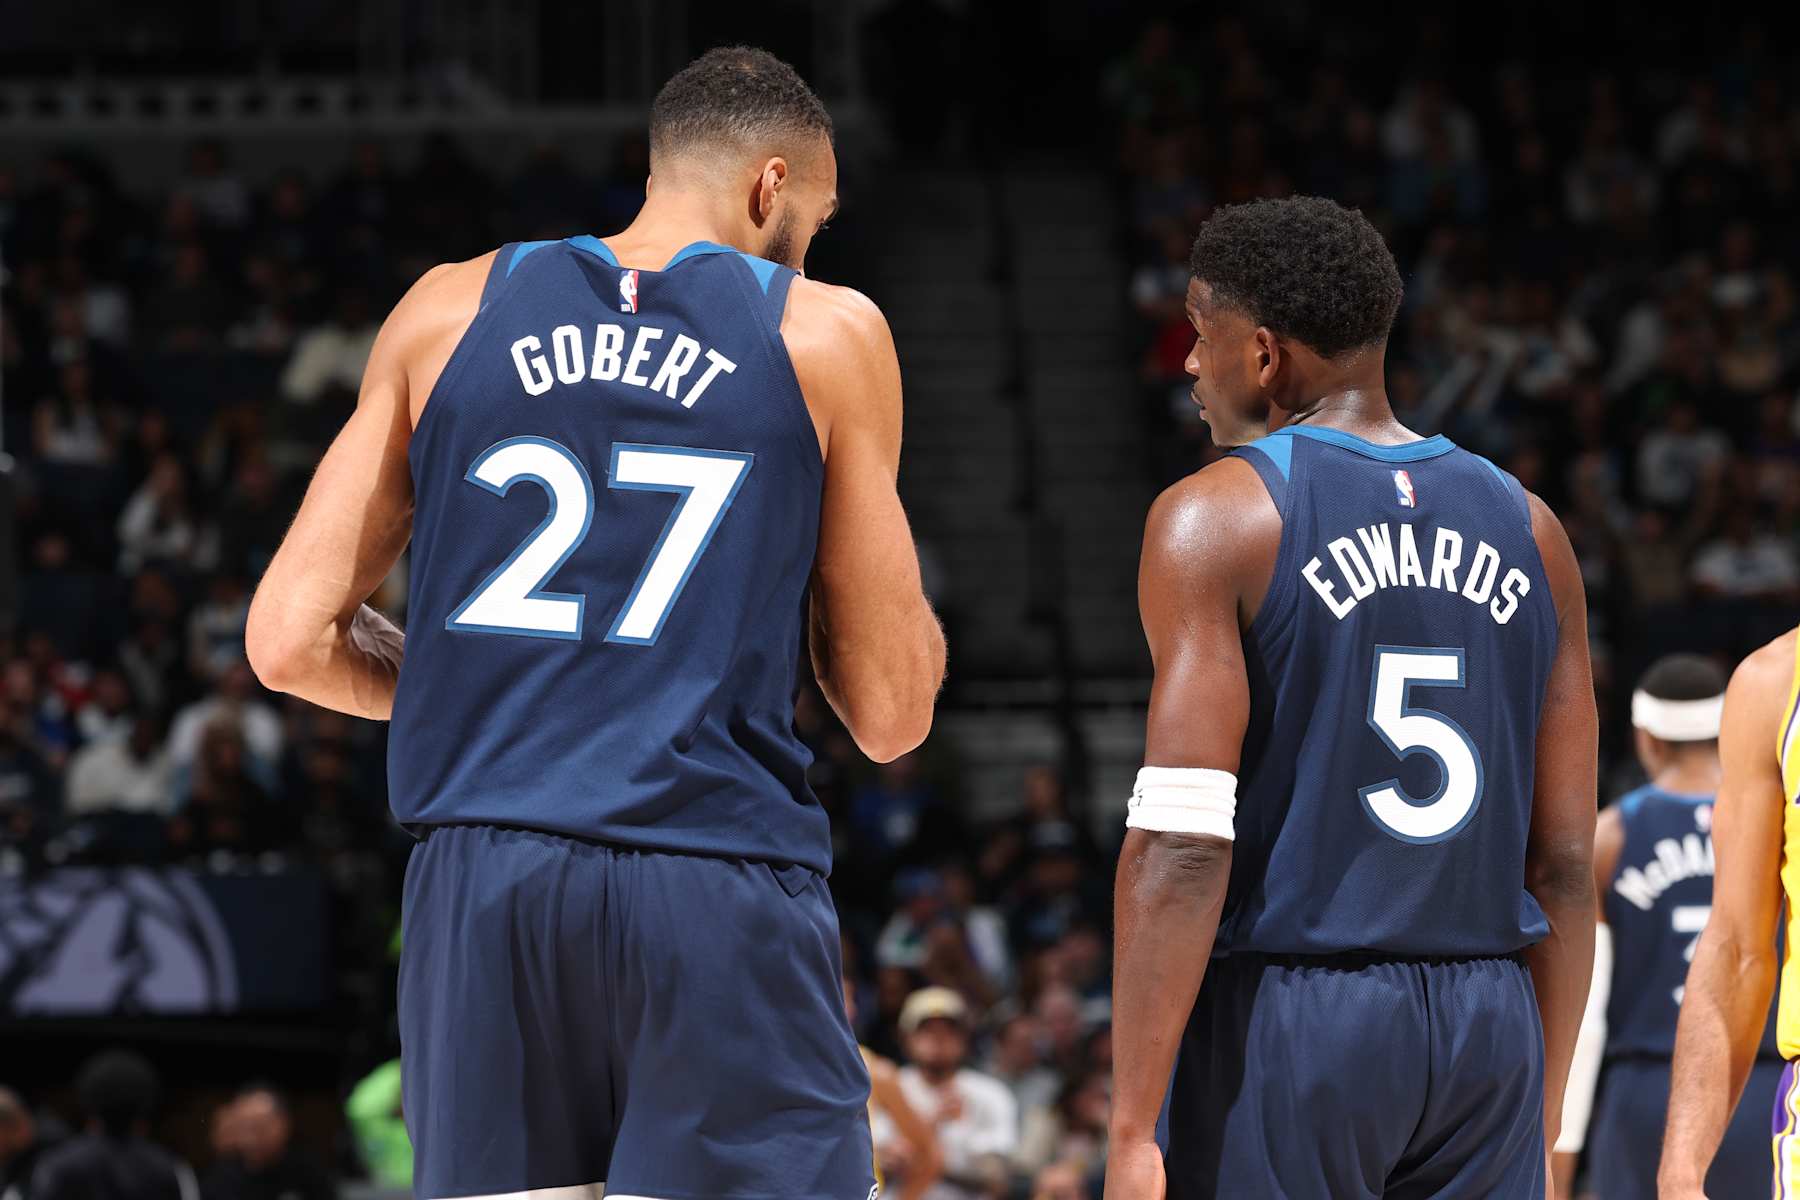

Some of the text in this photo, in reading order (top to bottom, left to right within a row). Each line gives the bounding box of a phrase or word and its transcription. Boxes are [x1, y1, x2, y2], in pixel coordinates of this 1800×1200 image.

[511, 324, 737, 409] GOBERT
[445, 435, 755, 647] 27
[1302, 523, 1531, 625] EDWARDS
[1357, 644, 1484, 845] 5
